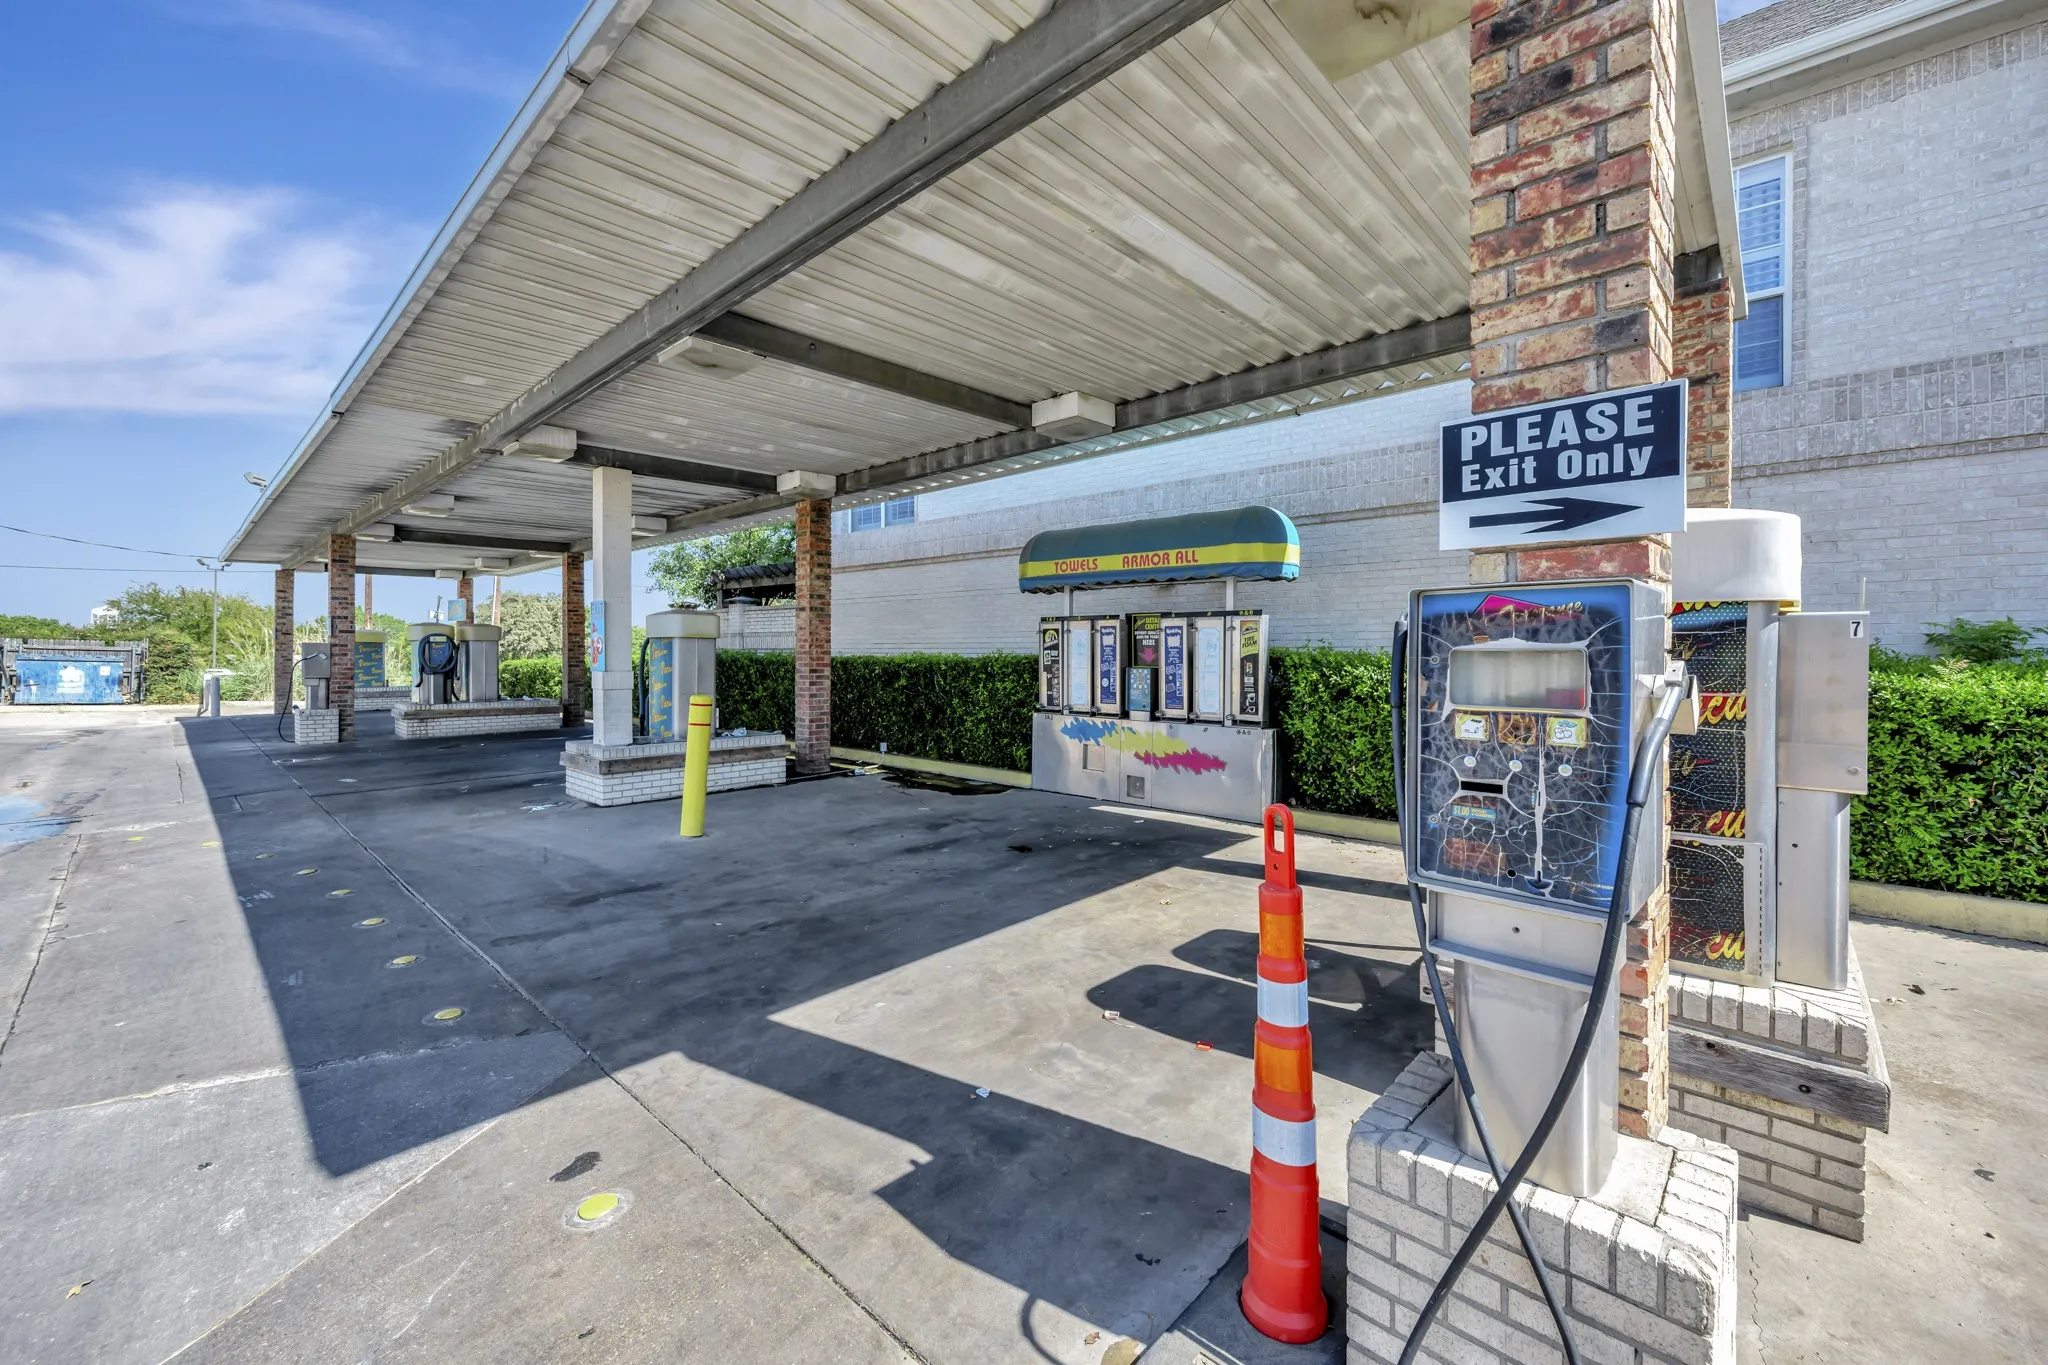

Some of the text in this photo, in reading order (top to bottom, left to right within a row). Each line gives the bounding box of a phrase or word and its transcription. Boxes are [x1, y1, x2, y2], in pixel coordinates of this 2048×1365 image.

[1461, 395, 1654, 461] PLEASE
[1461, 443, 1653, 493] Exit Only
[1054, 550, 1198, 574] TOWELS ARMOR ALL
[1851, 621, 1861, 637] 7
[1242, 640, 1258, 649] FOAM
[1243, 635, 1255, 643] TIRE
[1453, 805, 1470, 816] $1.00
